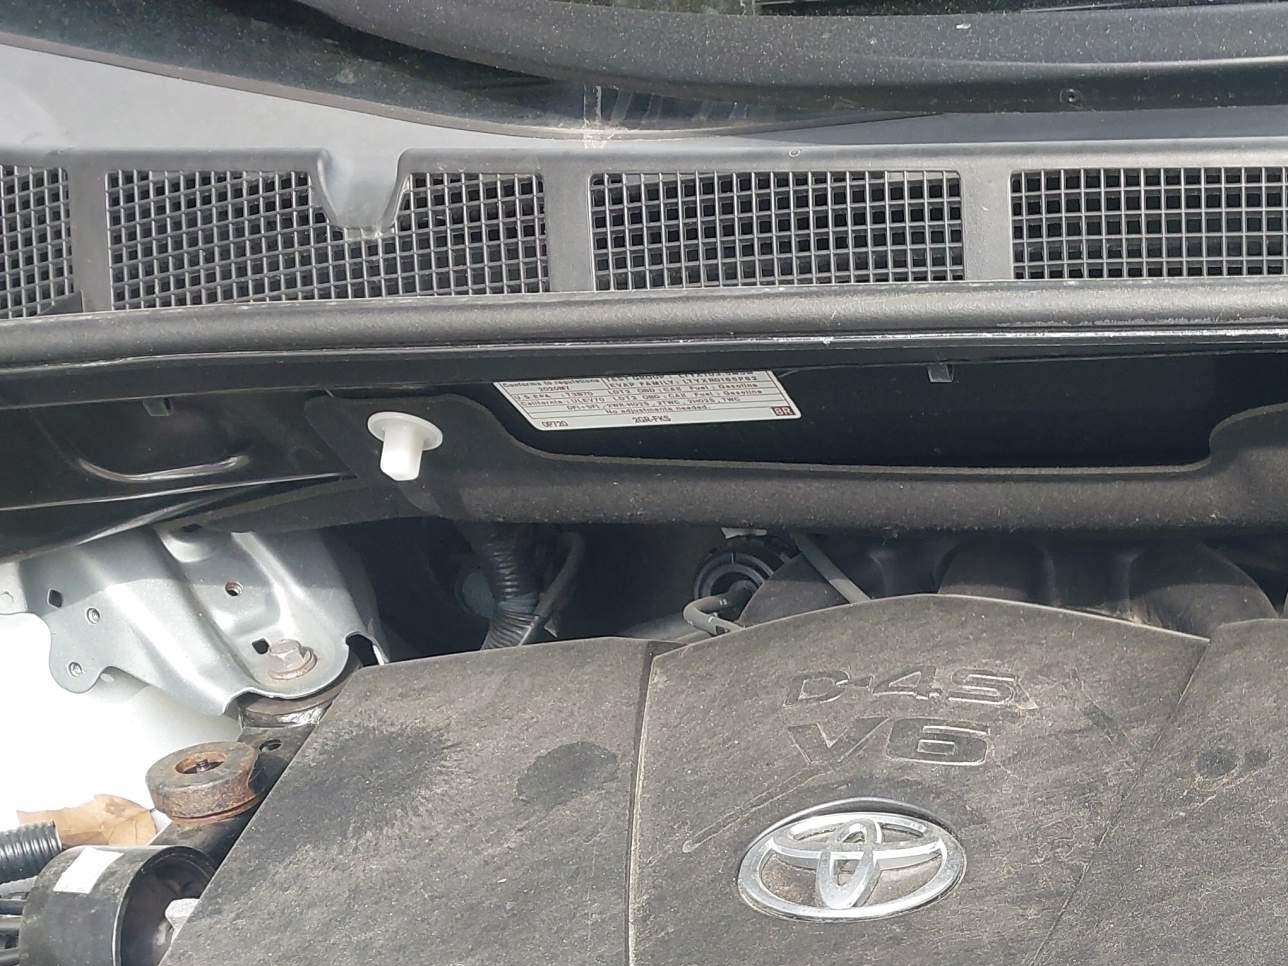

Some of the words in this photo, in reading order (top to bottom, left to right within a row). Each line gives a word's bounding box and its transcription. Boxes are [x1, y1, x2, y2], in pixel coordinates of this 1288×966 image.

[632, 415, 672, 423] 2GR-FKS
[783, 665, 1033, 708] D-4S
[786, 716, 991, 766] V6
